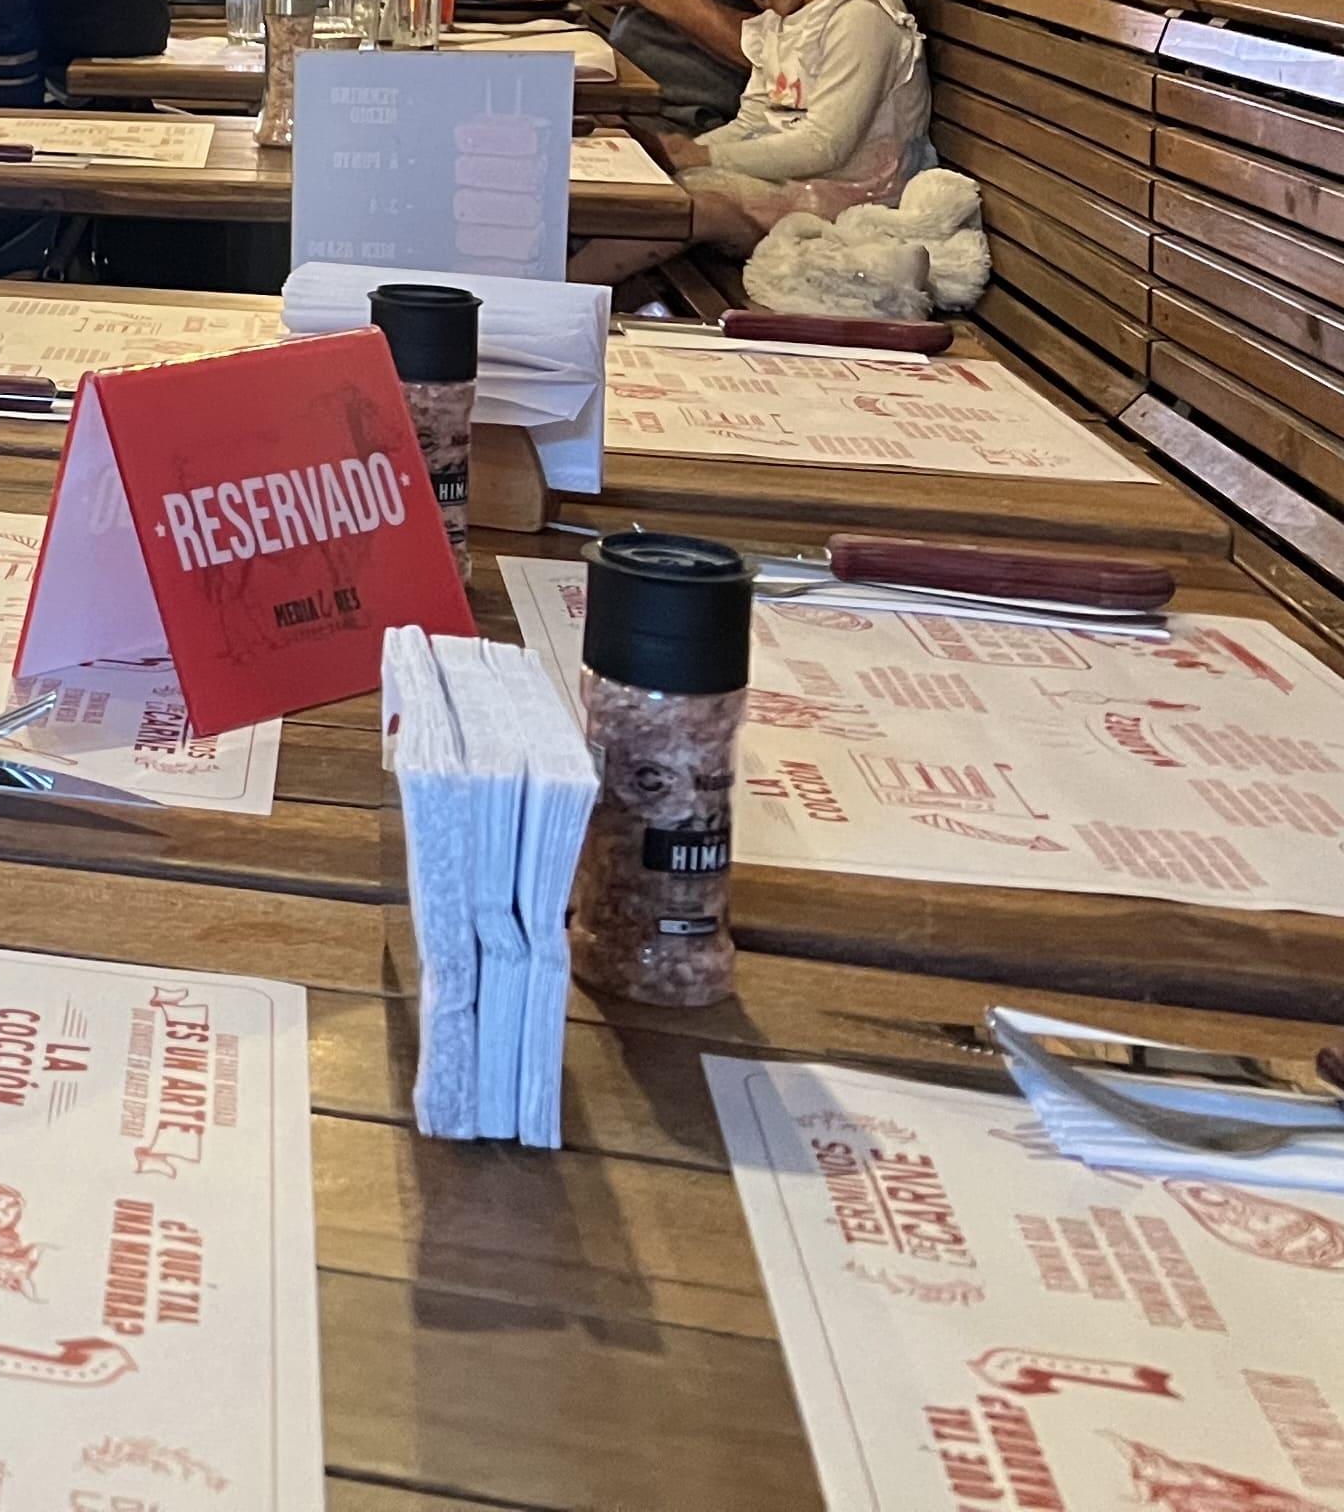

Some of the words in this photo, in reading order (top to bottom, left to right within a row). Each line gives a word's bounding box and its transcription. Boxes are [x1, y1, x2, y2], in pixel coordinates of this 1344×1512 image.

[163, 452, 406, 572] RESERVADO
[133, 709, 185, 755] CARNE
[745, 778, 790, 798] LA
[165, 1020, 210, 1043] ES
[42, 1043, 92, 1072] LA
[163, 1046, 209, 1073] UN
[158, 1075, 209, 1135] ARTE
[869, 1148, 967, 1246] CARNE
[111, 1199, 154, 1236] UNA
[102, 1236, 152, 1337] MADURA?
[157, 1289, 200, 1325] TAL
